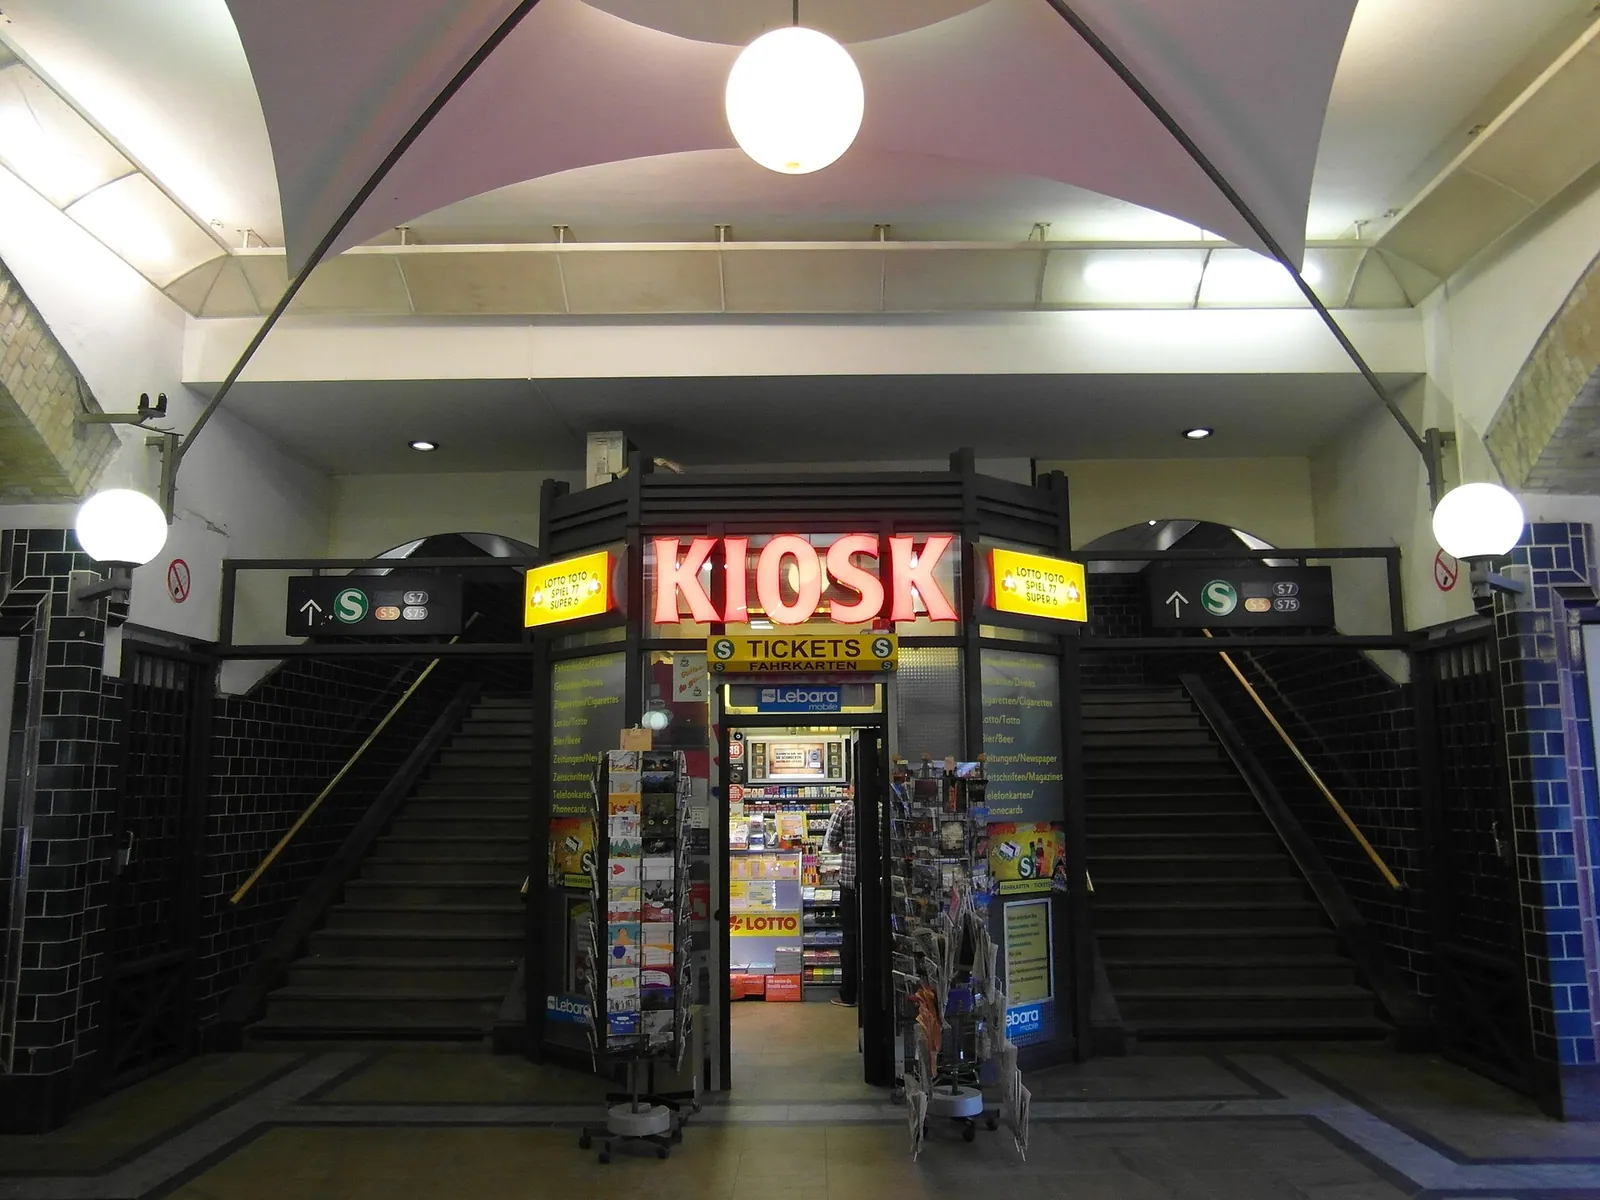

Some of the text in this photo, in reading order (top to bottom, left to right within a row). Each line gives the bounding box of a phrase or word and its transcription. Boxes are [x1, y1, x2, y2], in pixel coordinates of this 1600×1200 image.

[544, 571, 588, 588] LOTTO TOTO
[654, 533, 960, 625] KIOSK
[1016, 566, 1065, 584] LOTTO TOTO
[551, 584, 580, 599] SPIEL 77
[1025, 580, 1057, 594] SPIEL 77
[1276, 584, 1293, 595] S7
[408, 593, 424, 603] S7
[550, 597, 580, 610] SUPER 6
[1026, 592, 1058, 606] SUPER 6
[1207, 582, 1233, 615] S
[1276, 599, 1297, 610] S75
[338, 590, 364, 622] S
[380, 608, 425, 618] S5 S75
[747, 639, 861, 658] TICKETS
[750, 661, 857, 671] FAHRKARTEN
[777, 688, 838, 703] Lebara
[809, 703, 838, 711] mobile
[986, 790, 1035, 801] elefonkarten/
[746, 916, 797, 930] LOTTO
[1006, 1010, 1039, 1026] ebara
